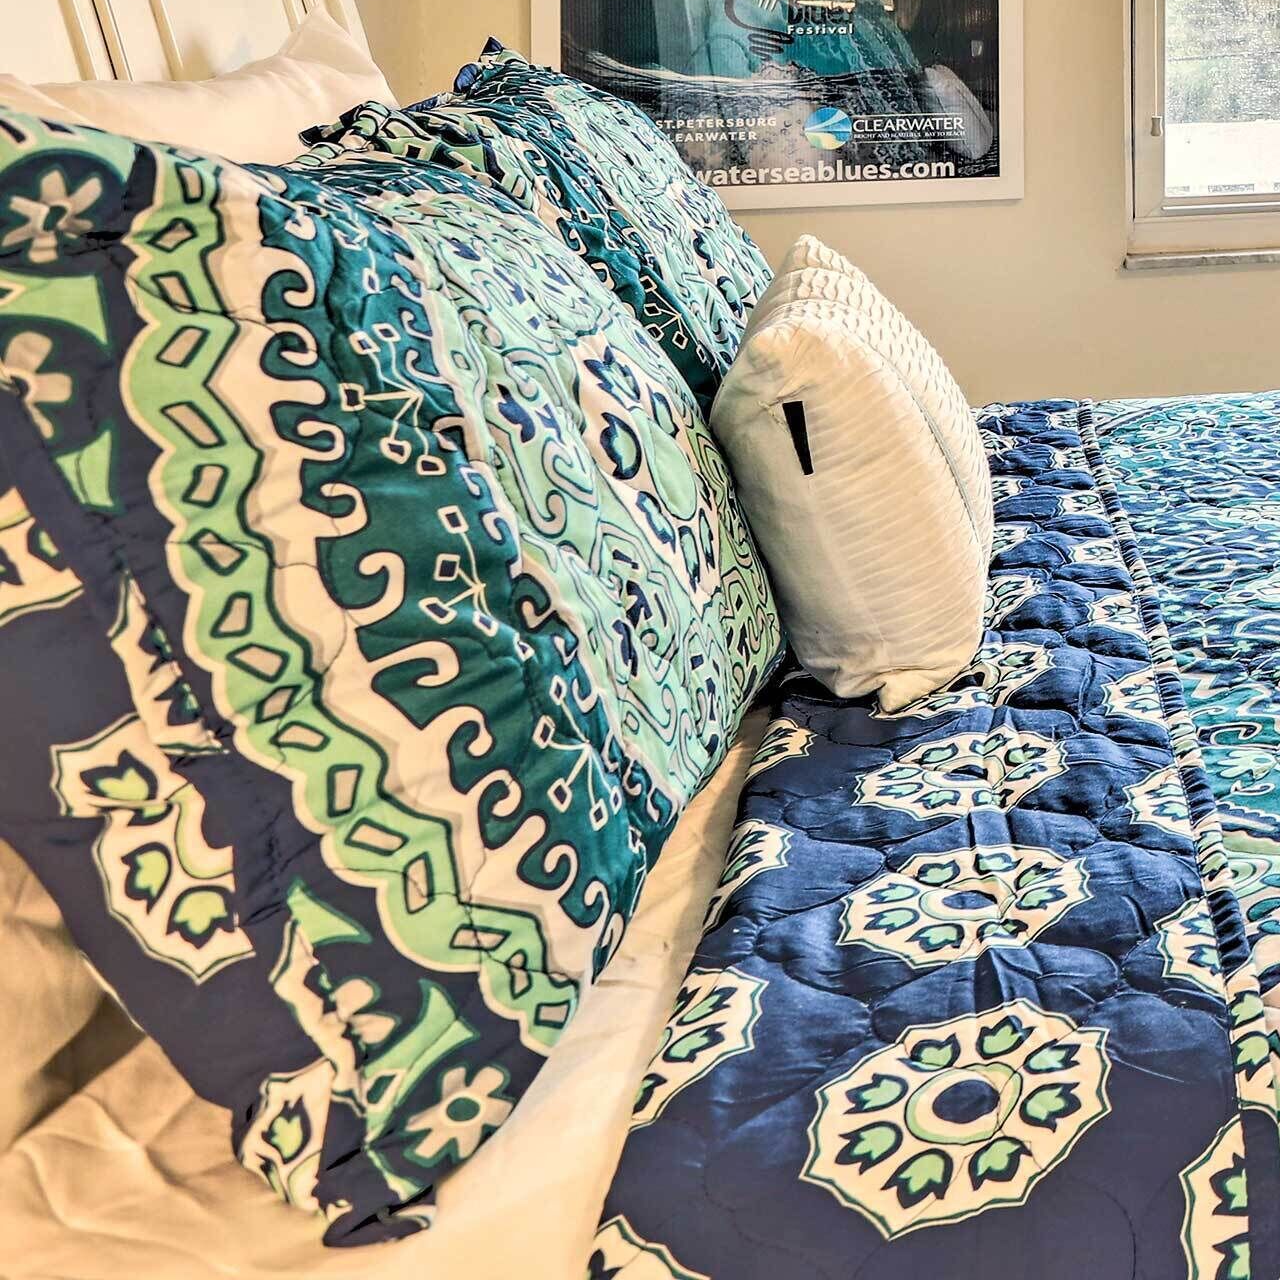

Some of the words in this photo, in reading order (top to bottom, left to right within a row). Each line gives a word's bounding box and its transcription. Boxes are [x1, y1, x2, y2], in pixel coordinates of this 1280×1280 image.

[787, 23, 854, 35] Festival
[655, 117, 777, 129] ST.PETERSBURG
[852, 117, 965, 132] CLEARWATER
[696, 159, 956, 185] waterseablues.com
